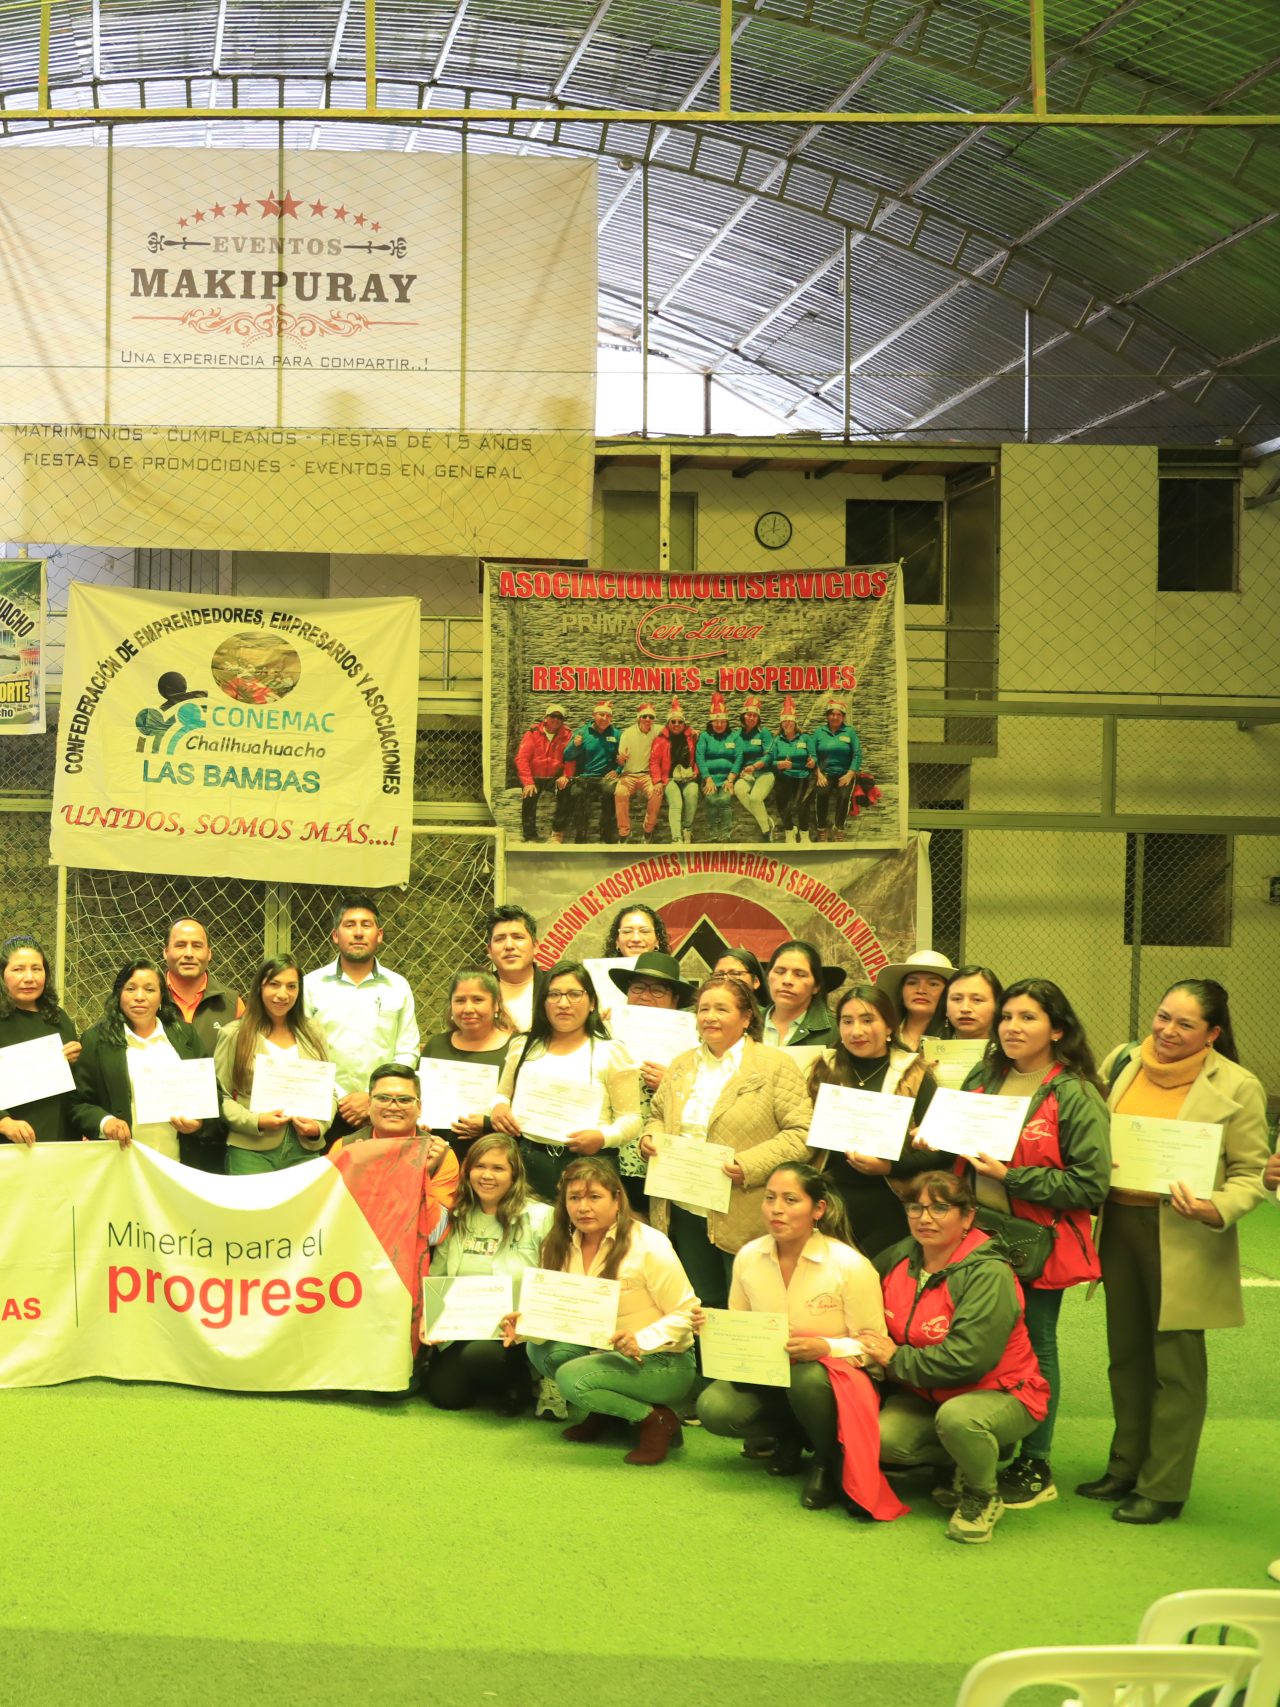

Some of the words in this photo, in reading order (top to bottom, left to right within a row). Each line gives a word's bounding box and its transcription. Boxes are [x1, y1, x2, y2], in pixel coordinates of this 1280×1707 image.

[212, 235, 343, 257] EVENTOS
[130, 268, 418, 304] MAKIPURAY
[163, 353, 265, 367] EXPERIENCIA
[272, 355, 314, 368] PARA
[14, 423, 143, 442] MATRIMONIOS
[320, 432, 398, 448] FIESTAS
[407, 434, 433, 449] DE
[444, 434, 470, 450] 15
[23, 452, 99, 468] FIESTAS
[108, 455, 135, 470] DE
[141, 456, 281, 474] PROMOCIONES
[304, 460, 392, 477] EVENTOS
[400, 463, 426, 478] EN
[434, 463, 523, 481] GENERAL
[667, 570, 888, 600] MULTISERVICIOS
[117, 639, 139, 664] DE
[270, 611, 365, 679] EMPRESARIOS
[354, 672, 370, 687] Y
[532, 666, 701, 692] RESTAURANTES
[719, 666, 857, 692] HOSPEDAJES
[65, 658, 123, 775] CONFEDERACIÓN
[211, 705, 335, 733] CONEMAC
[185, 735, 326, 759] Challhuahuacho
[361, 685, 401, 796] ASOCIACIONES
[143, 759, 195, 786] LAS
[203, 764, 321, 794] BAMBAS
[60, 804, 185, 836] UNIDOS,
[197, 814, 294, 841] SOMOS
[534, 903, 589, 971] OCIACIÓN
[580, 889, 605, 917] DE
[777, 864, 788, 887] Y
[786, 866, 856, 929] SERVICIOS
[108, 1221, 212, 1259] Minería
[225, 1236, 292, 1265] para
[302, 1228, 323, 1257] el
[108, 1264, 363, 1329] progreso
